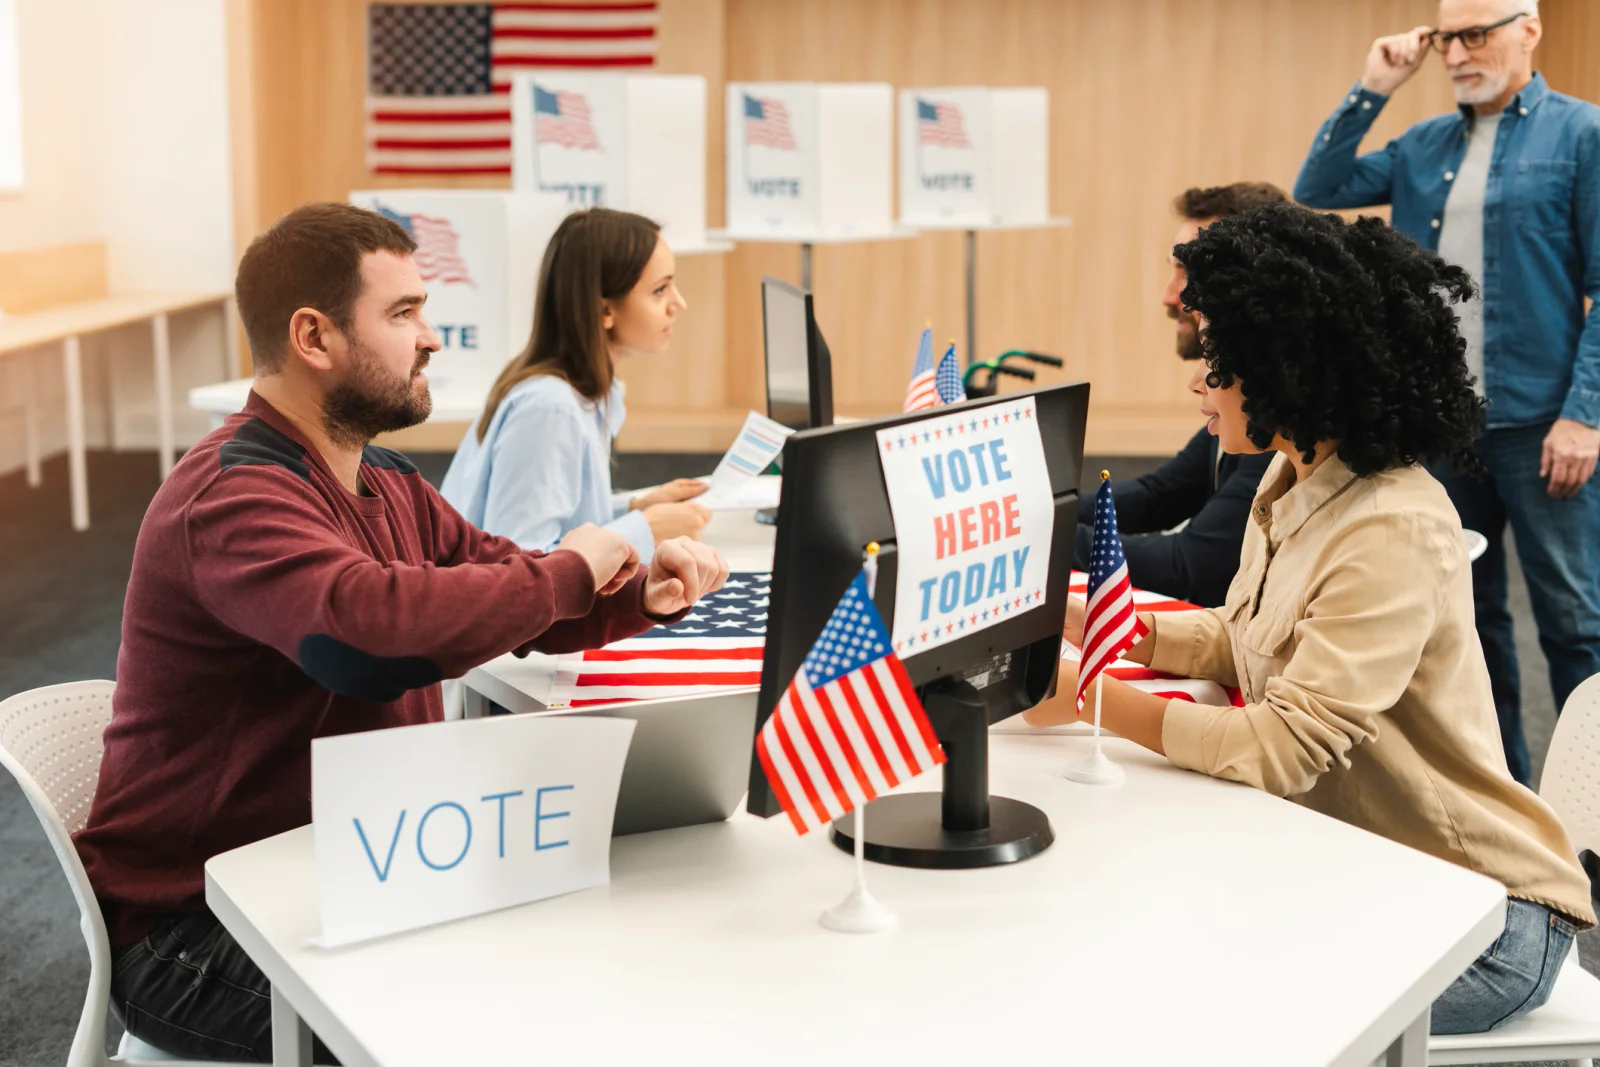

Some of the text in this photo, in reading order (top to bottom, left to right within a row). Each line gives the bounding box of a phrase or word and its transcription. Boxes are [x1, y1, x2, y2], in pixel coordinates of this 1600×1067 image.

[748, 177, 801, 198] VOTE
[921, 172, 975, 193] VOTE
[434, 324, 478, 349] TE
[921, 438, 1012, 500] VOTE
[933, 493, 1022, 560] HERE
[918, 545, 1030, 622] TODAY
[353, 784, 574, 883] VOTE
